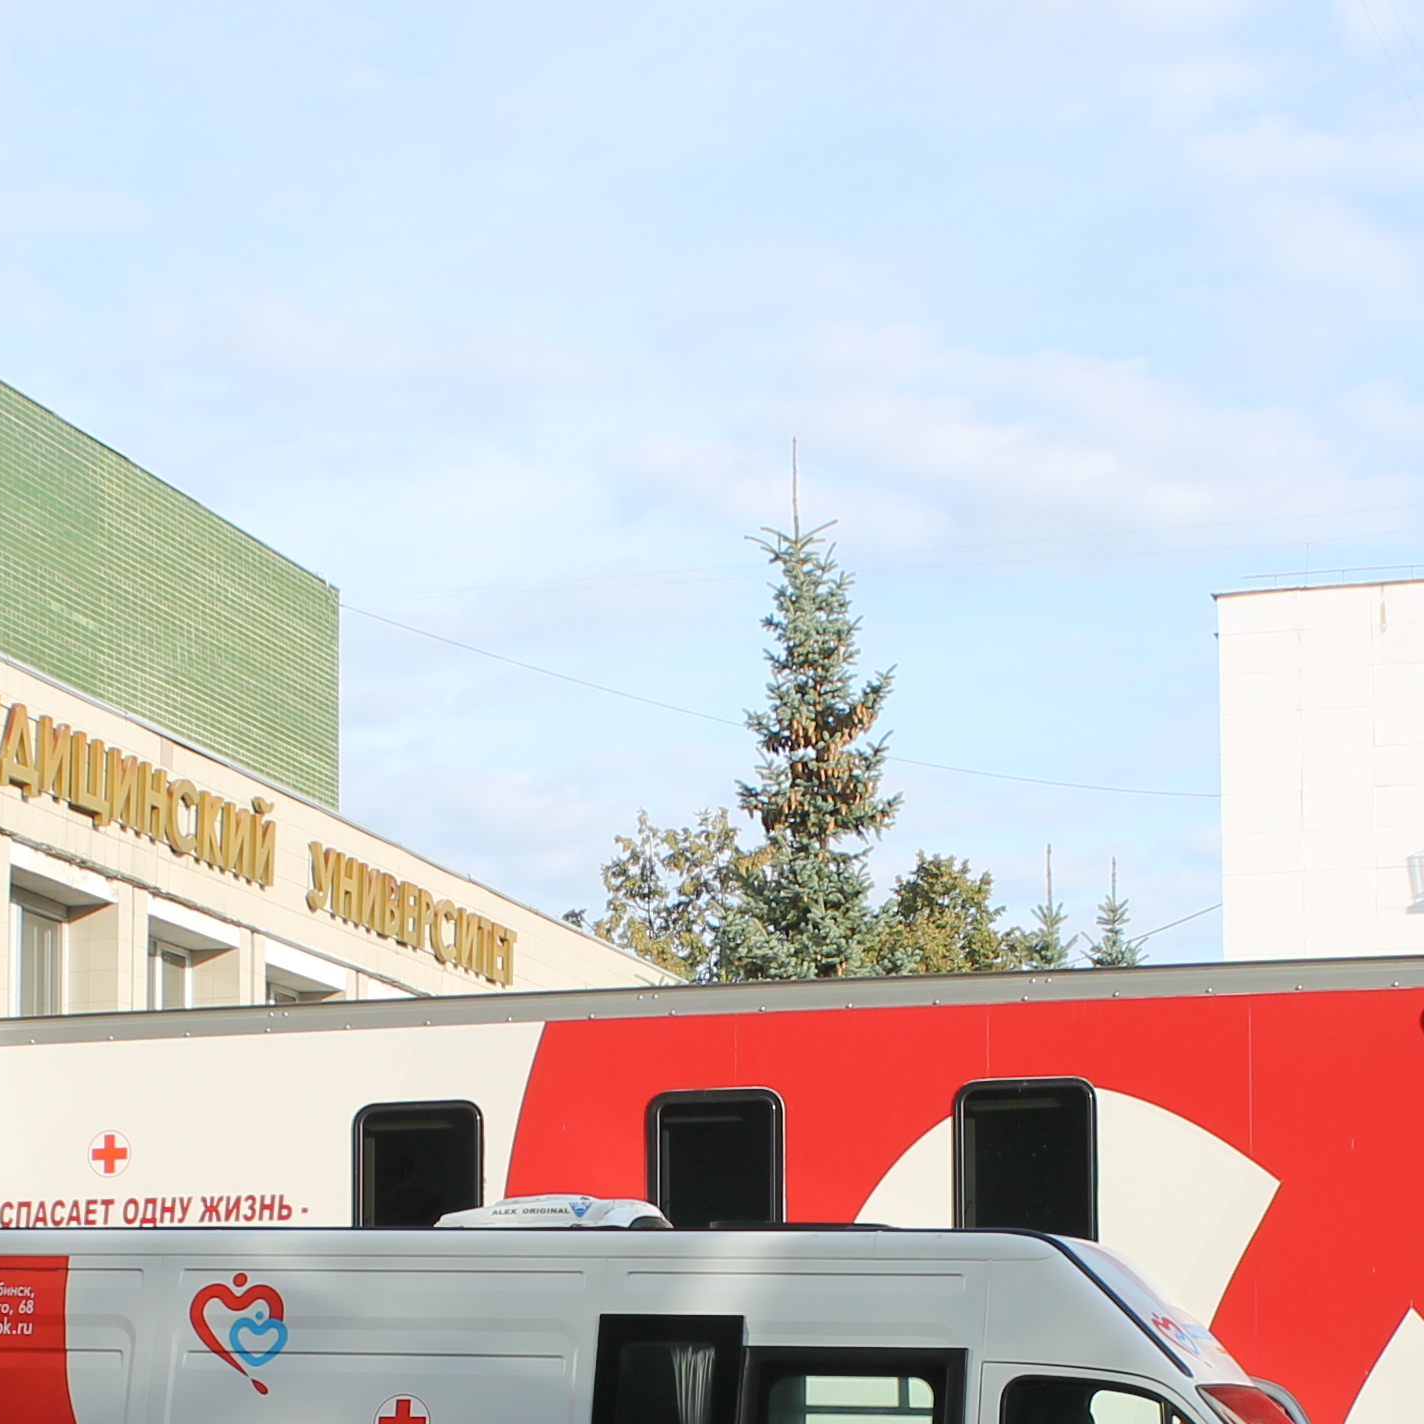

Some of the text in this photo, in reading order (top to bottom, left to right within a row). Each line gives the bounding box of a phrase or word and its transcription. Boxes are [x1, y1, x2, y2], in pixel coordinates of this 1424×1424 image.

[306, 840, 518, 986] УНИВЕРСИТЕТ
[123, 1196, 193, 1228] ОДНУ
[198, 1194, 293, 1223] ЖИЗНЬ
[522, 1207, 570, 1215] ORIGINAL
[18, 1299, 34, 1314] 68
